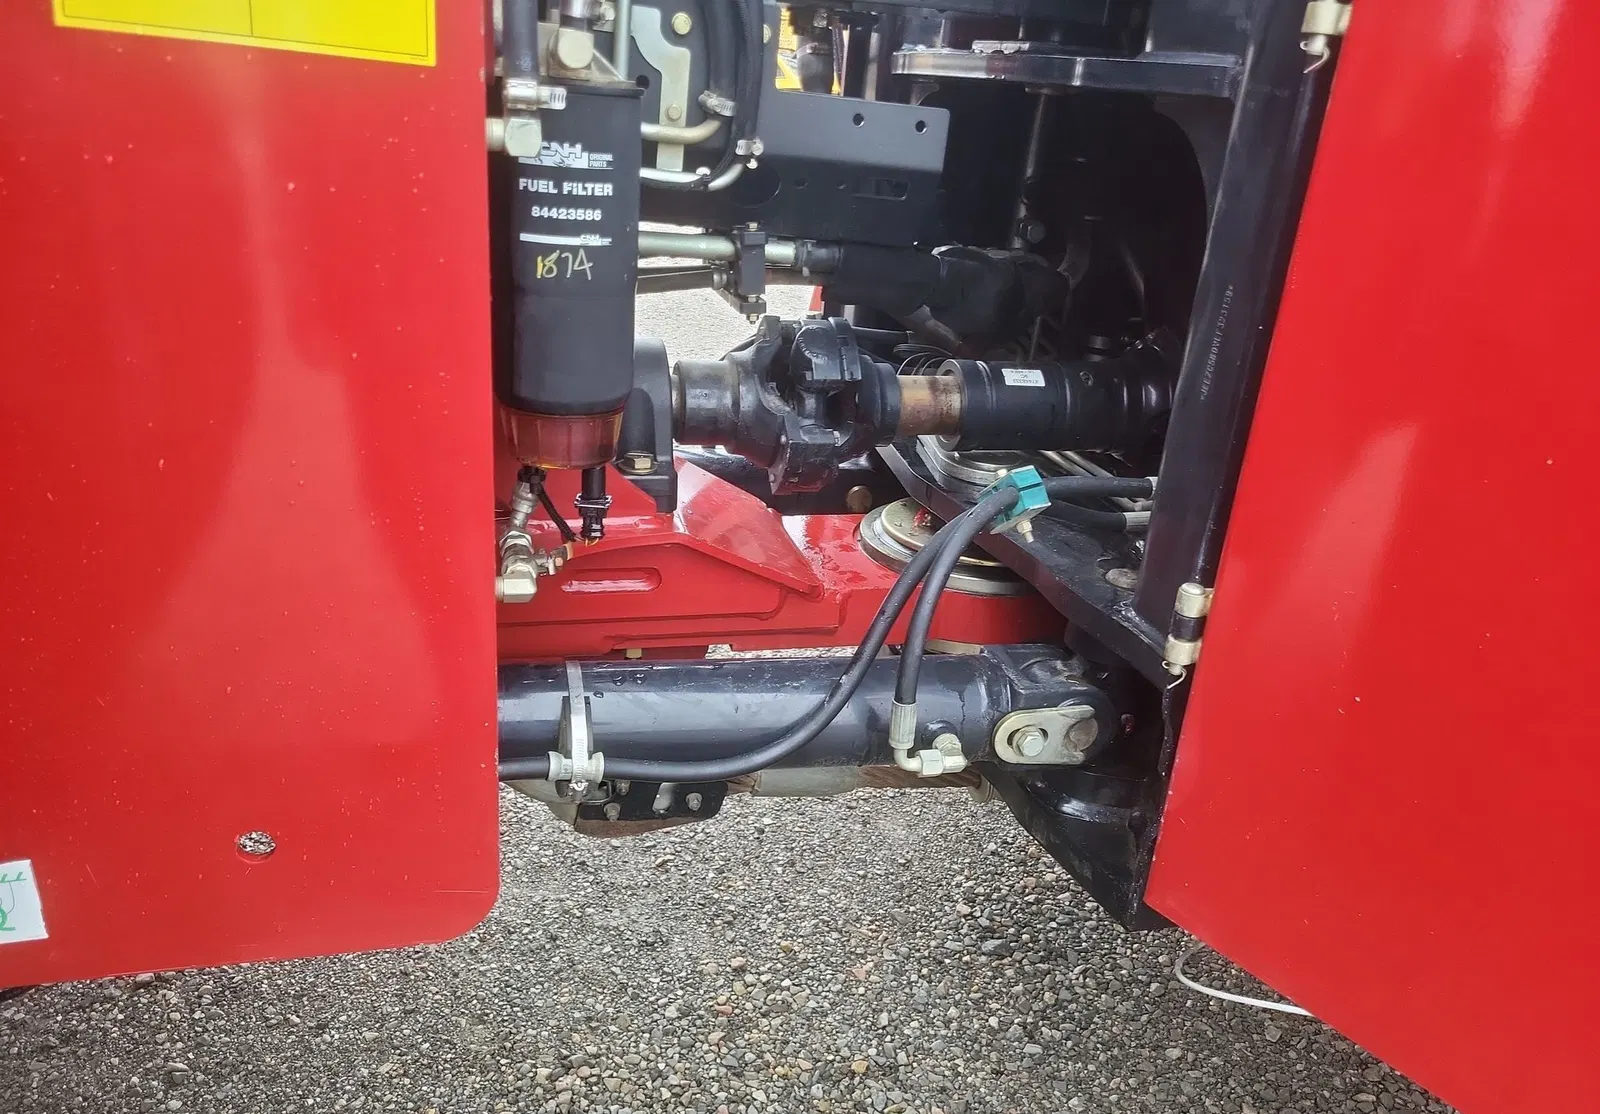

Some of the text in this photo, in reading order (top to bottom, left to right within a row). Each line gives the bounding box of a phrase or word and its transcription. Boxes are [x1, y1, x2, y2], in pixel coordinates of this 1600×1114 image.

[540, 141, 614, 161] CNH ORIGINAL
[519, 178, 613, 196] FUEL FILTER
[531, 206, 602, 221] 84423586
